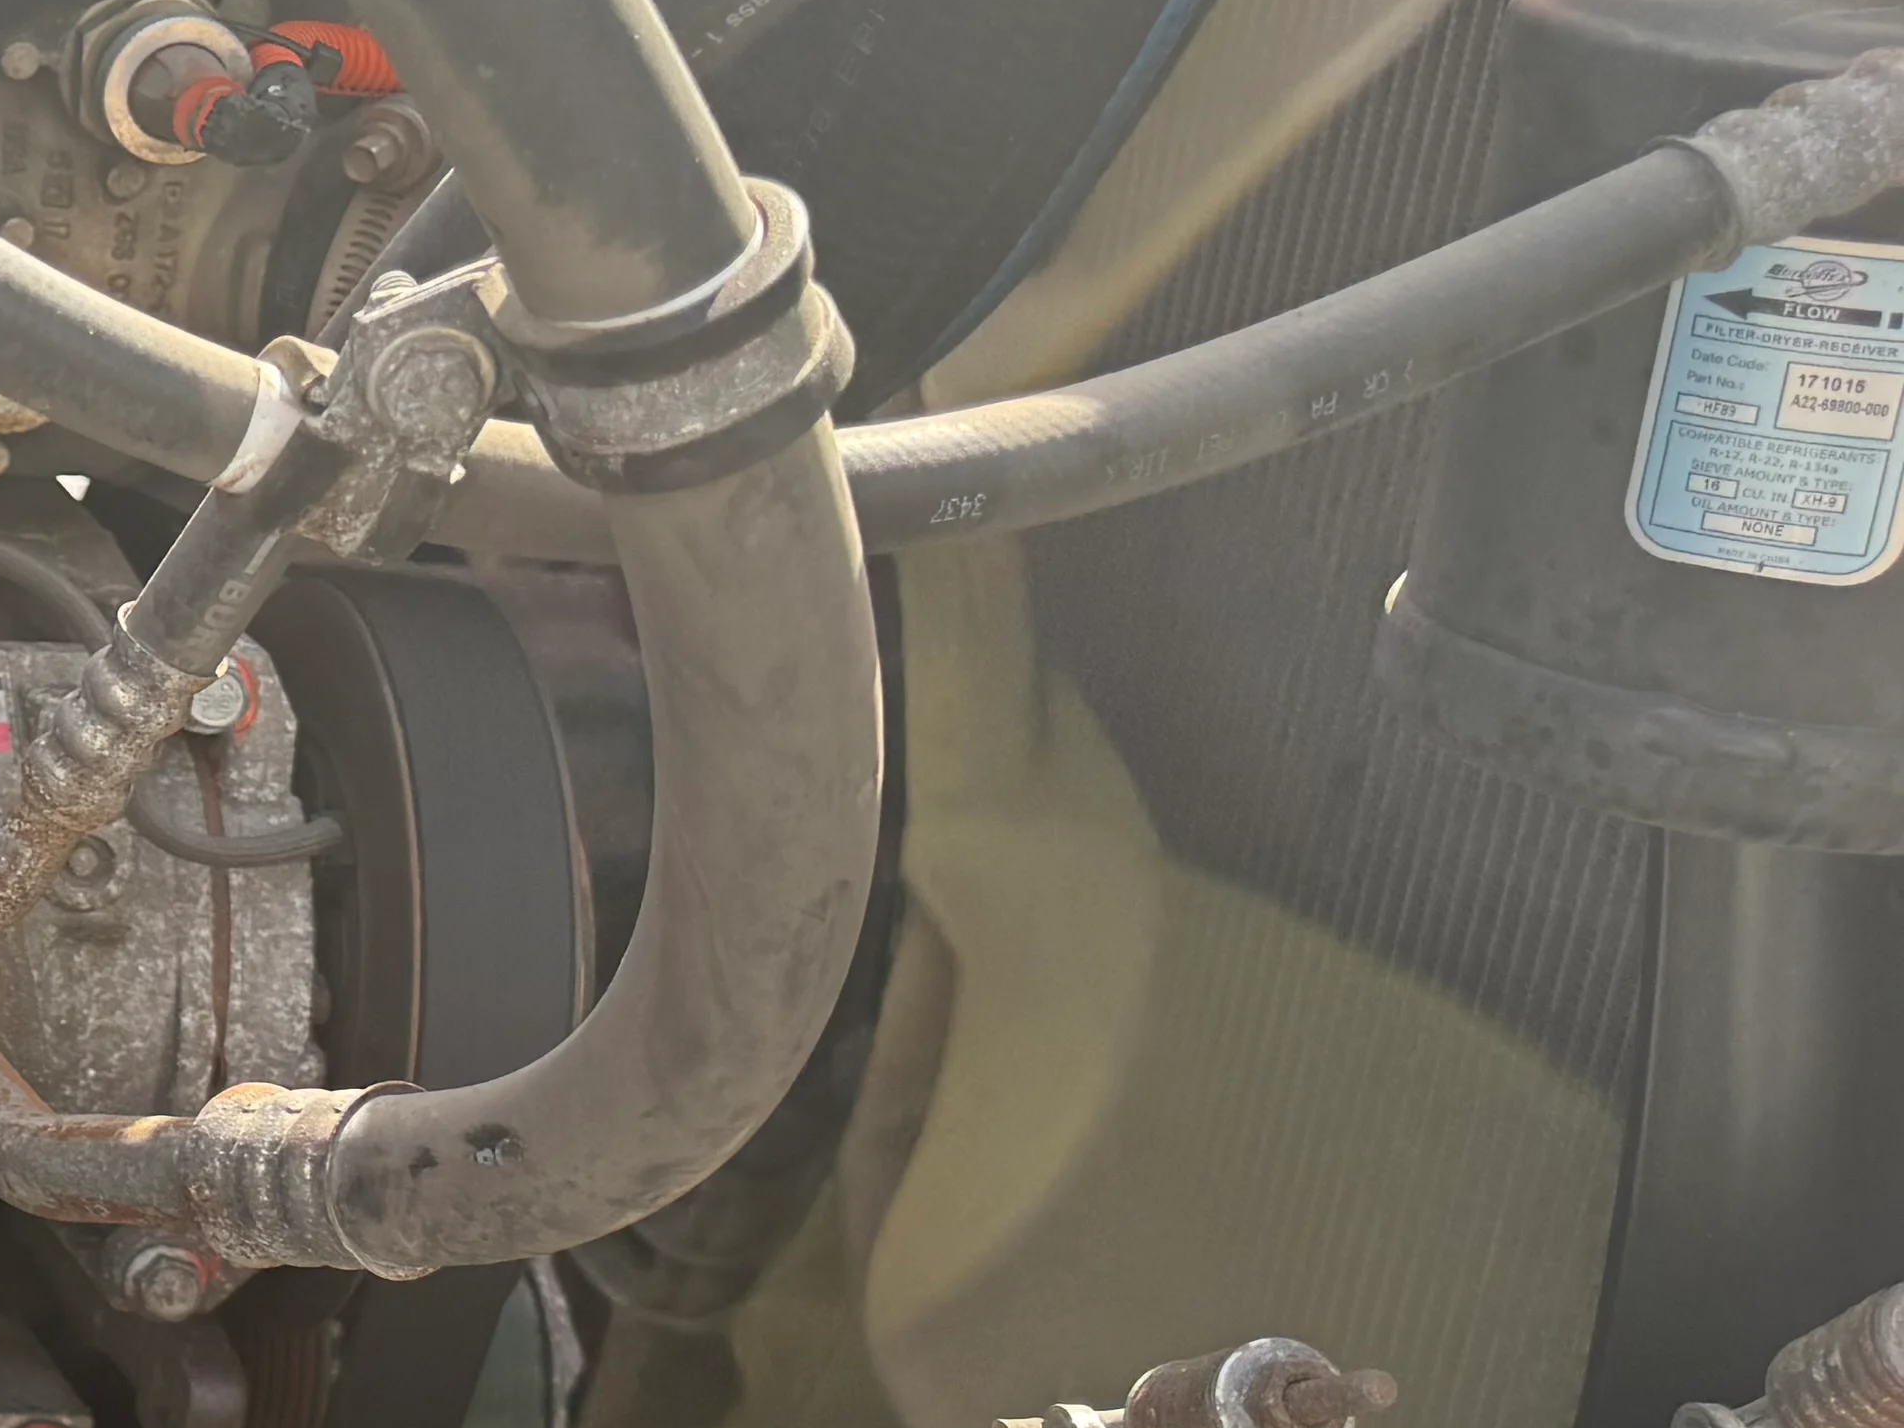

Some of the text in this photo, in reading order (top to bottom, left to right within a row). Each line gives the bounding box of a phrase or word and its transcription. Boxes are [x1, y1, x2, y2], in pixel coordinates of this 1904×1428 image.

[1782, 302, 1841, 321] FLOW
[1692, 348, 1725, 365] Date
[1687, 371, 1713, 386] Part
[1311, 392, 1338, 421] PA
[1678, 427, 1764, 453] COMPATIBLE
[1691, 458, 1731, 476] SIEVE
[1733, 465, 1796, 486] AMOUNT
[930, 493, 988, 525] 3437
[1691, 496, 1714, 511] OIL
[1716, 501, 1779, 522] AMOUNT
[1741, 520, 1785, 537] NONE
